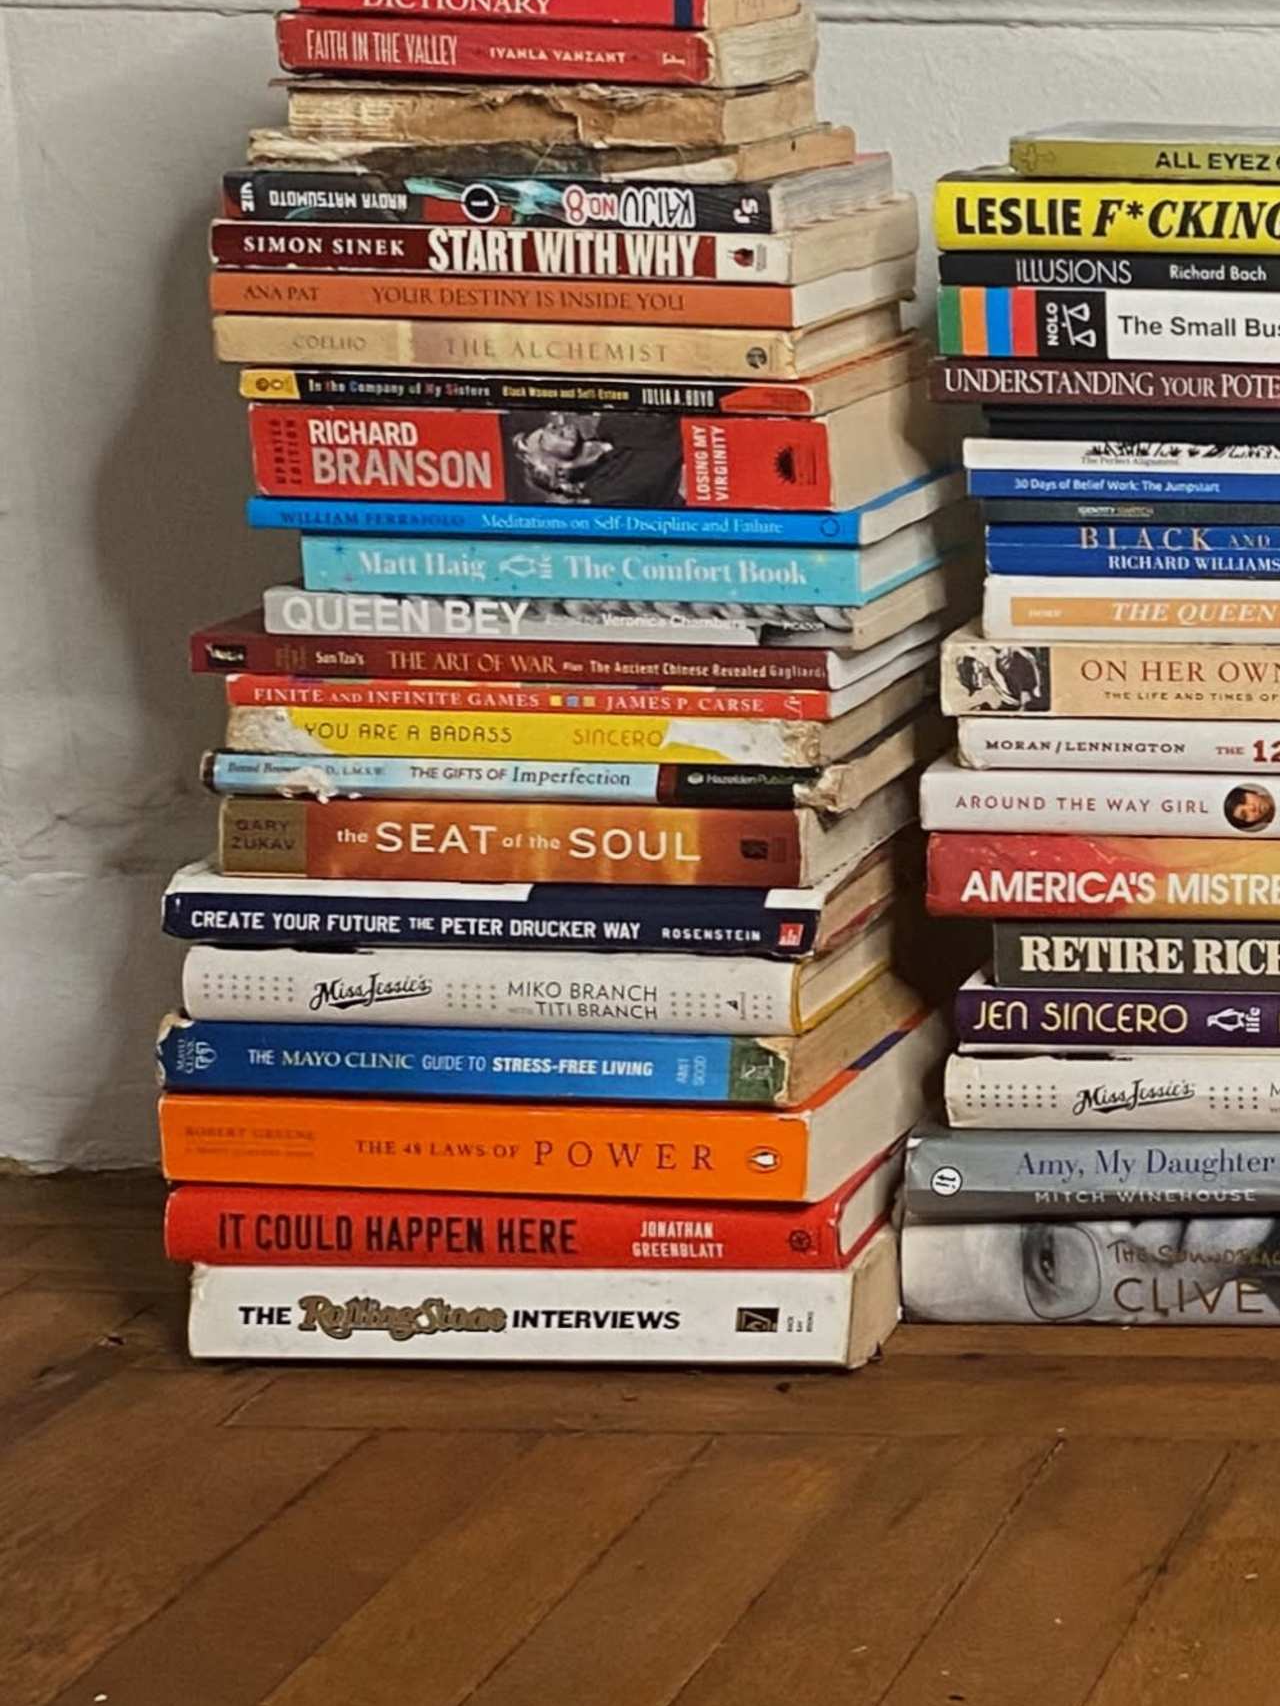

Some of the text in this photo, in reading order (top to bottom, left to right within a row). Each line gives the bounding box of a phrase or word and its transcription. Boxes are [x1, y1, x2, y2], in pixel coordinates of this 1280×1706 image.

[306, 29, 458, 66] FAITH THE VALLEY
[1156, 151, 1270, 170] ALL EYEZ
[269, 189, 407, 210] NAOYA MATSUMOTO
[620, 187, 696, 228] KAIJU
[956, 197, 1082, 236] LESLIE
[243, 236, 405, 257] SIMON SINEK
[427, 227, 700, 278] START WITH WHY
[1016, 258, 1266, 284] ILLUSIONS Richard Bach
[371, 287, 632, 310] YOUR DESTINY INSIDE
[1046, 302, 1059, 346] NOLO
[1118, 315, 1163, 335] The
[1170, 315, 1236, 337] Small
[512, 341, 668, 363] ALCHEMIST
[350, 380, 404, 396] Company
[945, 367, 1154, 397] UNDERSTANDING
[1160, 376, 1216, 397] YOUR
[307, 418, 418, 446] RICHARD
[312, 447, 492, 489] BRANSON
[691, 424, 712, 501] LOSING MY
[710, 425, 730, 501] VIRGINITY
[1030, 478, 1105, 493] Days Belief
[1080, 526, 1213, 551] BLACK
[357, 551, 487, 580] Matt Haig
[565, 555, 616, 580] The
[622, 556, 732, 582] Comfort
[738, 560, 807, 585] Book
[1108, 555, 1189, 570] RICHARD
[1195, 556, 1280, 572] WILLIAMS
[282, 596, 430, 633] QUEEN
[444, 600, 530, 635] BEY
[1111, 601, 1169, 622] THE
[1177, 602, 1275, 624] QUEEN
[388, 650, 558, 674] THE ART WAR
[1081, 660, 1127, 682] ON
[1142, 661, 1205, 683] HER
[254, 687, 540, 708] FINITE INFINITE GAMES
[605, 696, 765, 712] JAMES CARSE
[358, 723, 513, 743] ARE BADASS
[512, 766, 631, 787] Imperfection
[955, 795, 1209, 814] AROUND THE WAY GIRL
[376, 821, 702, 862] SEAT SOUL
[960, 870, 1156, 903] AMERICA'S
[191, 910, 641, 940] CREATE YOUR FUTURE PETER DRUCKER WAY
[661, 928, 762, 941] ROSENSTEIN
[1019, 935, 1184, 974] RETIRE
[508, 981, 658, 1002] MIKO BRANCH
[577, 1004, 659, 1020] BRANCH
[973, 1000, 1189, 1034] JEN SINCERO
[282, 1050, 655, 1076] MAYO CLINIC GUIDE STRESS-FREE LIVING
[1073, 1078, 1195, 1115] Miss Jessie's
[534, 1141, 714, 1171] POWER
[1097, 1148, 1276, 1183] My Daughter
[1035, 1188, 1256, 1204] MITCH WINEHOUSE
[255, 1214, 577, 1255] COULD HAPPEN HERE
[640, 1221, 713, 1239] JONATHAN
[632, 1242, 724, 1258] GREENBLATT
[1113, 1277, 1263, 1316] CLIVE
[239, 1306, 292, 1325] THE
[298, 1295, 418, 1341] Rolling
[512, 1309, 681, 1330] INTERVIEWS
